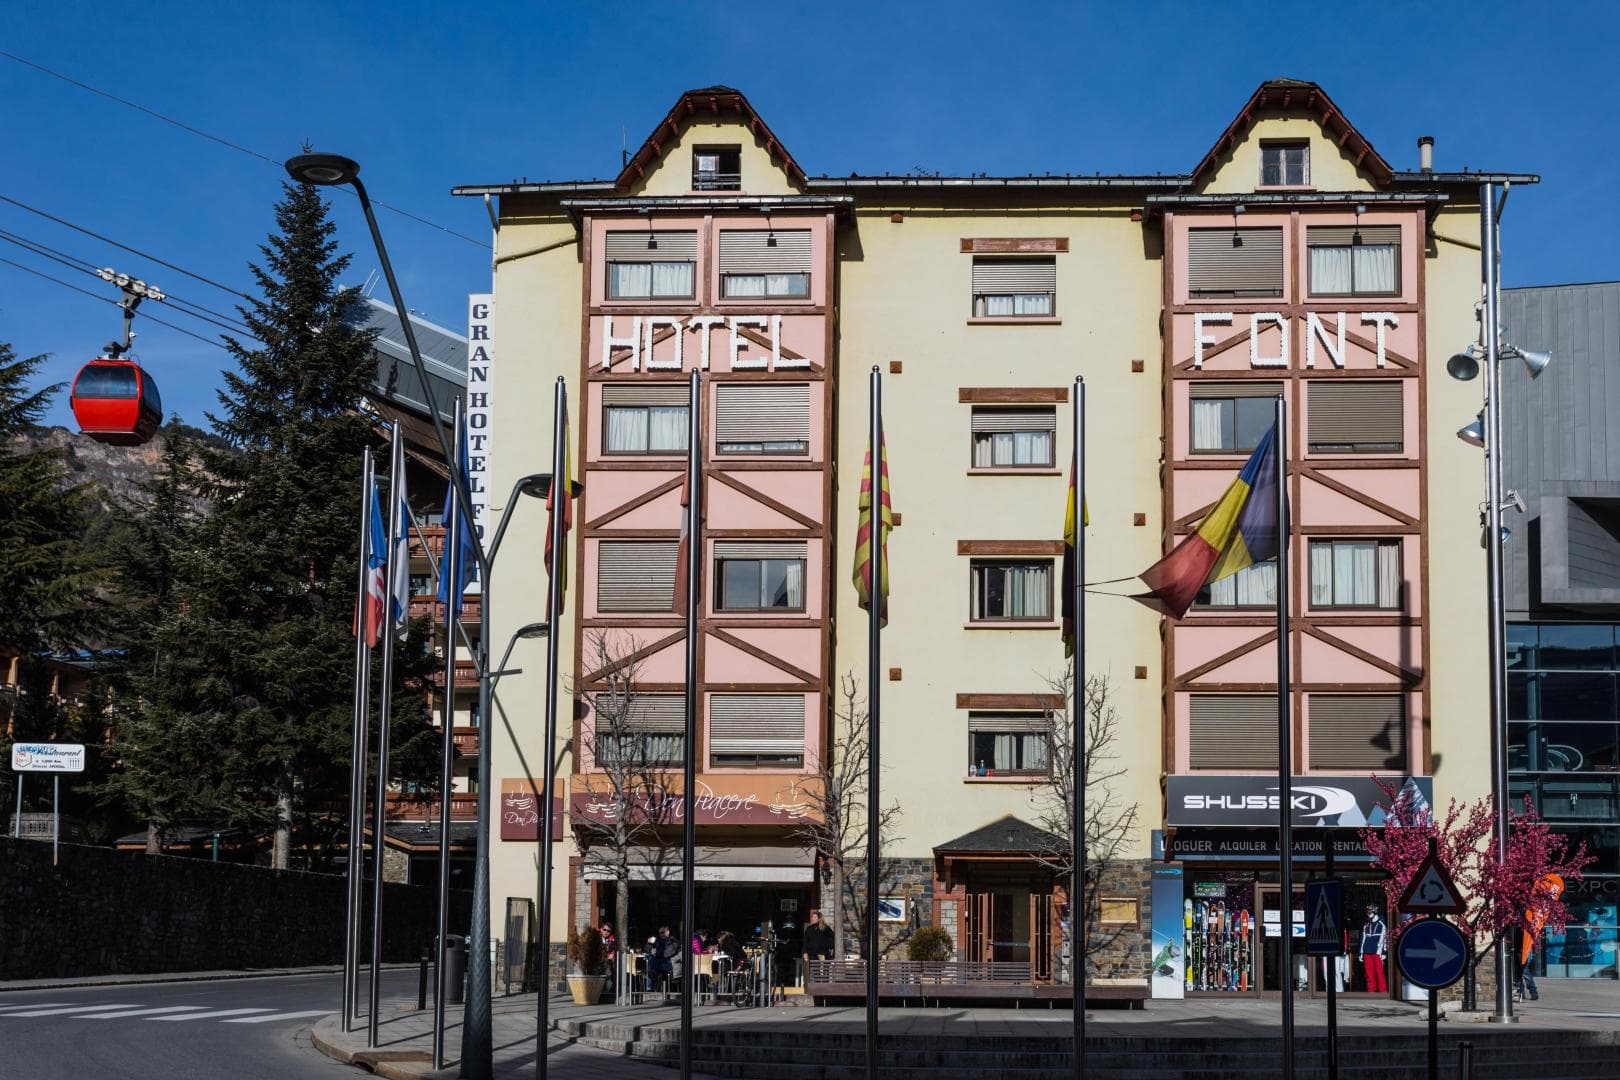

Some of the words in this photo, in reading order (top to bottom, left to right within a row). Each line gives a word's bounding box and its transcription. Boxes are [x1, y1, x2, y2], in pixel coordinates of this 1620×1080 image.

[469, 303, 490, 383] GRAN
[602, 315, 811, 369] HOTEL
[1194, 312, 1399, 369] FONT
[468, 392, 489, 494] HOTEL
[636, 783, 685, 818] Don
[694, 780, 760, 818] Piacere
[1184, 795, 1316, 810] SHUSSKI
[505, 811, 527, 826] Don
[1160, 840, 1213, 852] LOGUER
[1219, 841, 1267, 851] ALQUILER
[1275, 841, 1322, 851] LATION
